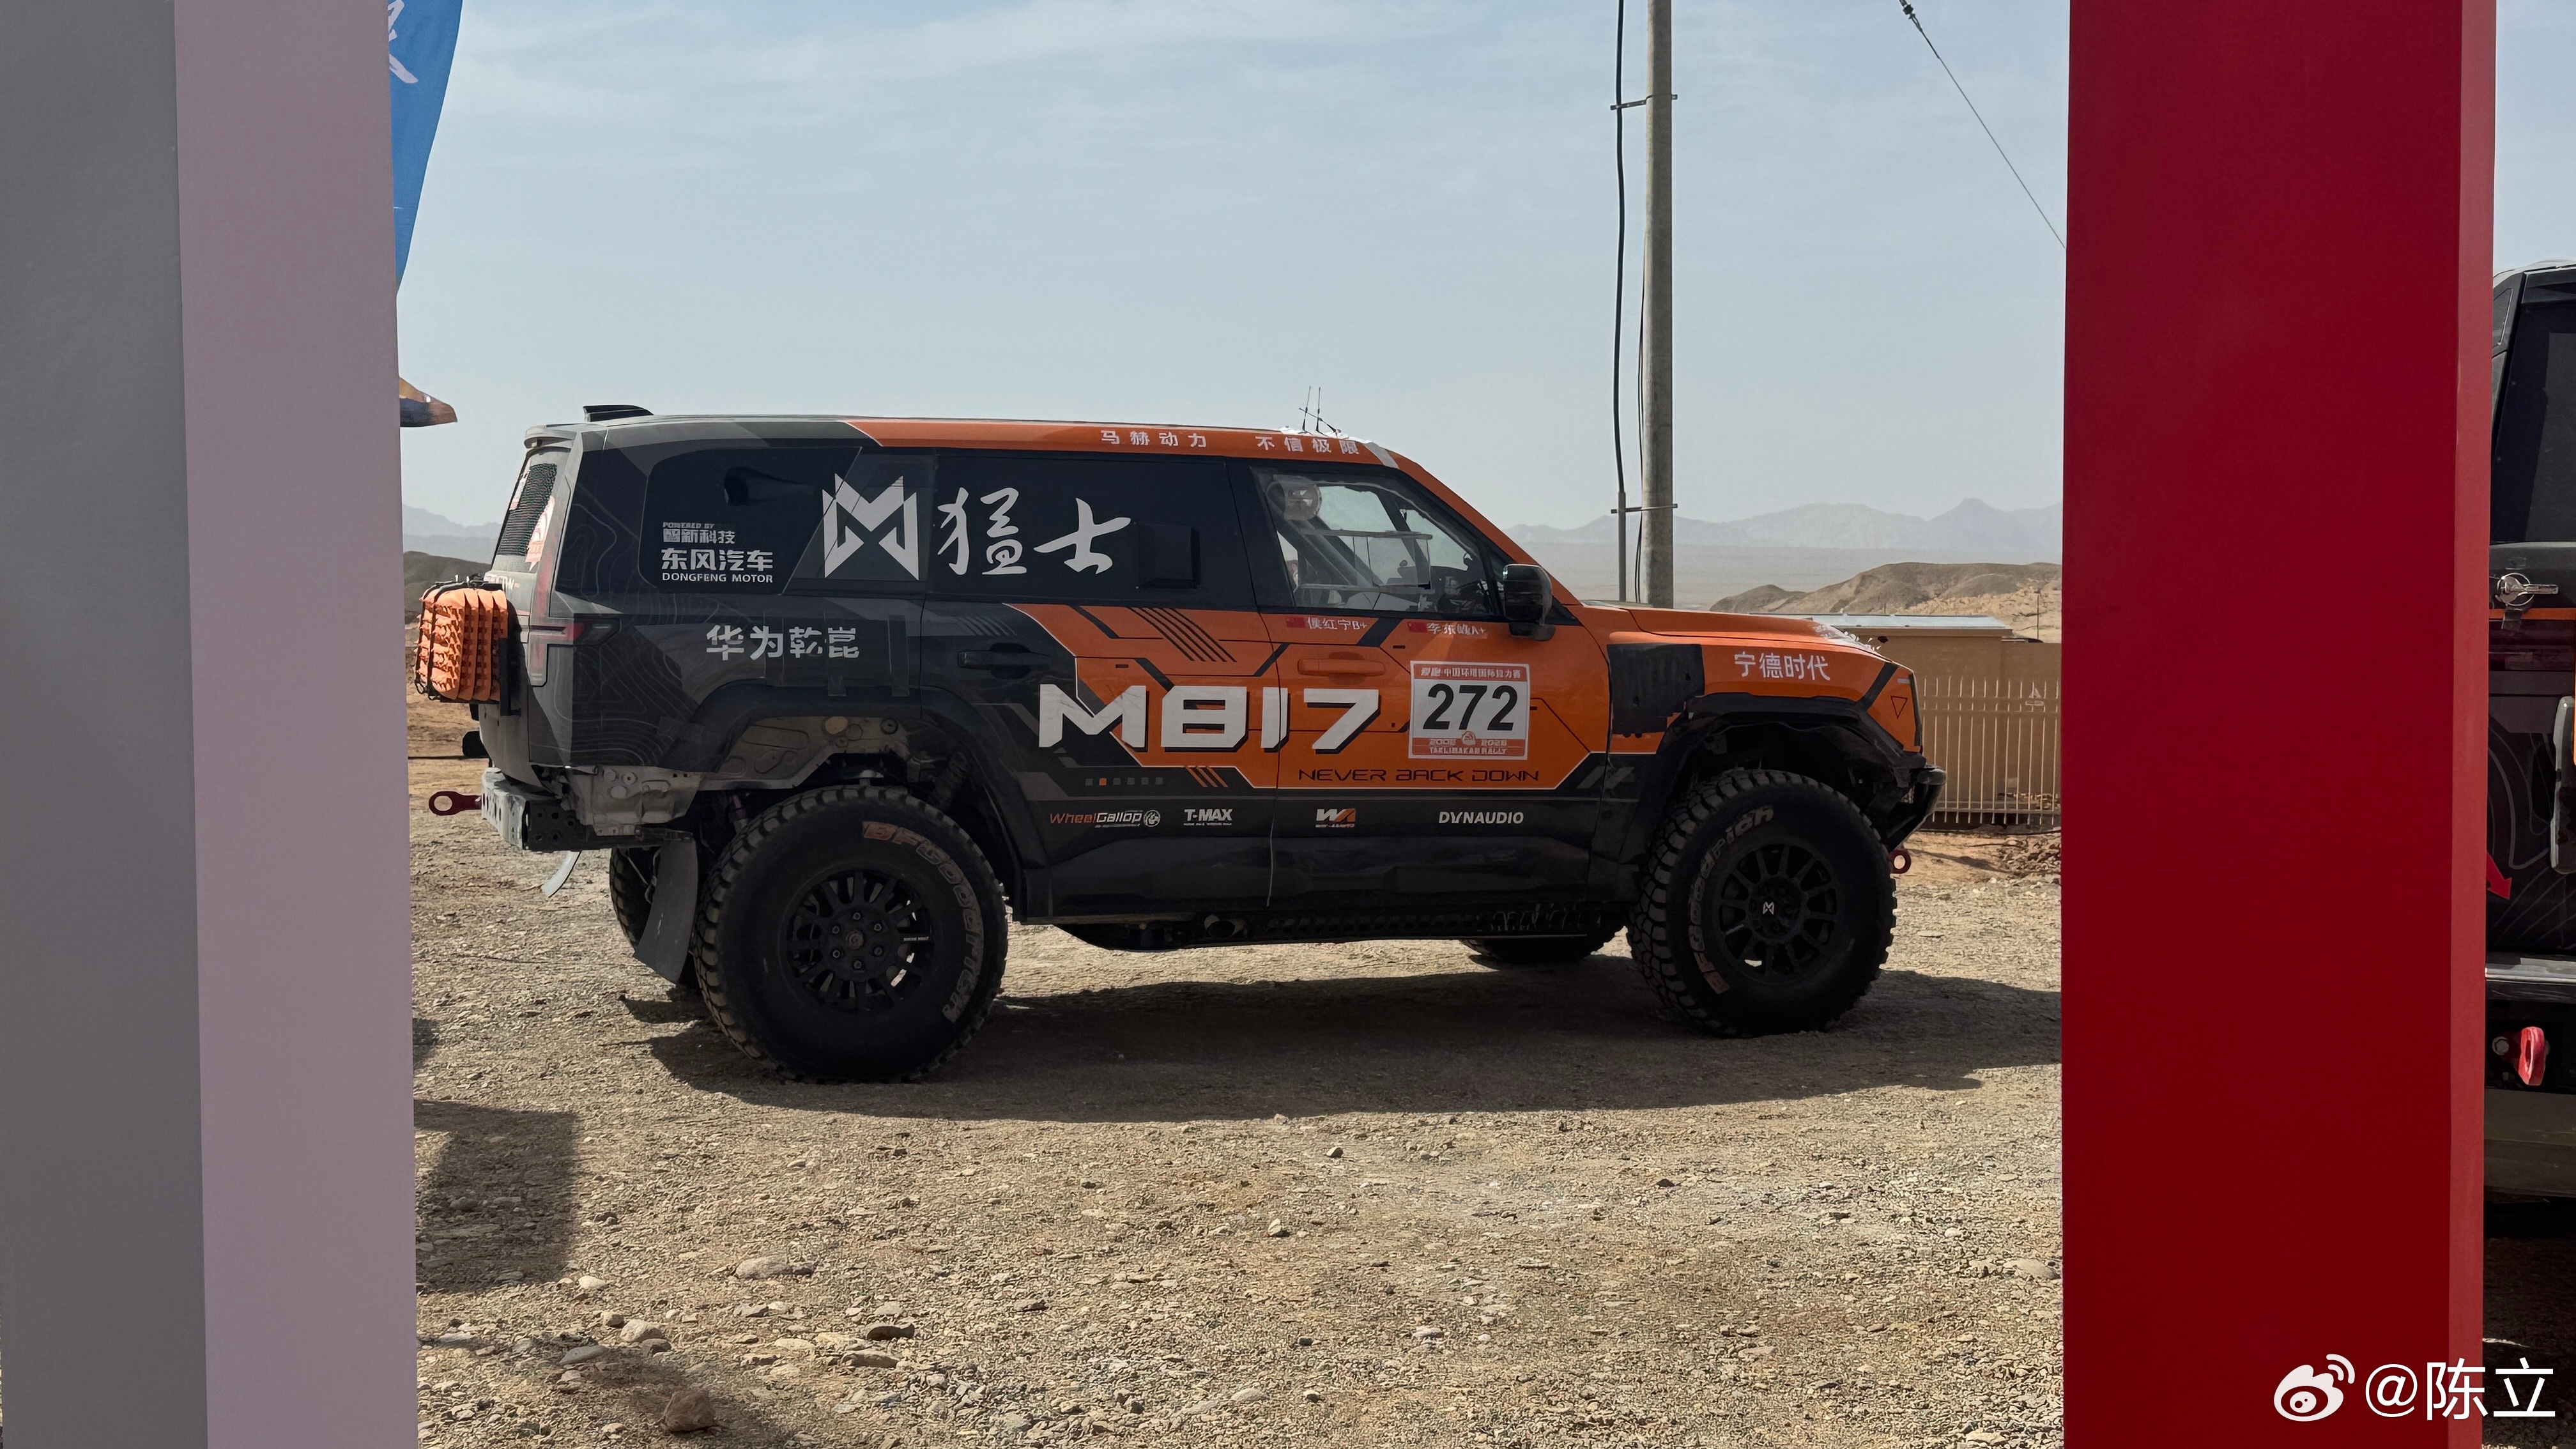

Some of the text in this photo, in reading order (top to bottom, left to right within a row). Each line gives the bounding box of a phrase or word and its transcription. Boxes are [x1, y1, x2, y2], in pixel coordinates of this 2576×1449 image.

[1100, 430, 1360, 455] 马赫动力 不信极限
[937, 487, 1131, 576] 猛士
[661, 548, 773, 572] 东风汽车
[662, 572, 773, 583] DONGFENG MOTOR
[1734, 651, 1831, 682] 宁德时代
[1039, 684, 1381, 754] M817
[1422, 683, 1519, 732] 272
[1298, 769, 1539, 782] NEVER BACK DOWN
[1438, 811, 1524, 825] DYNAUDIO
